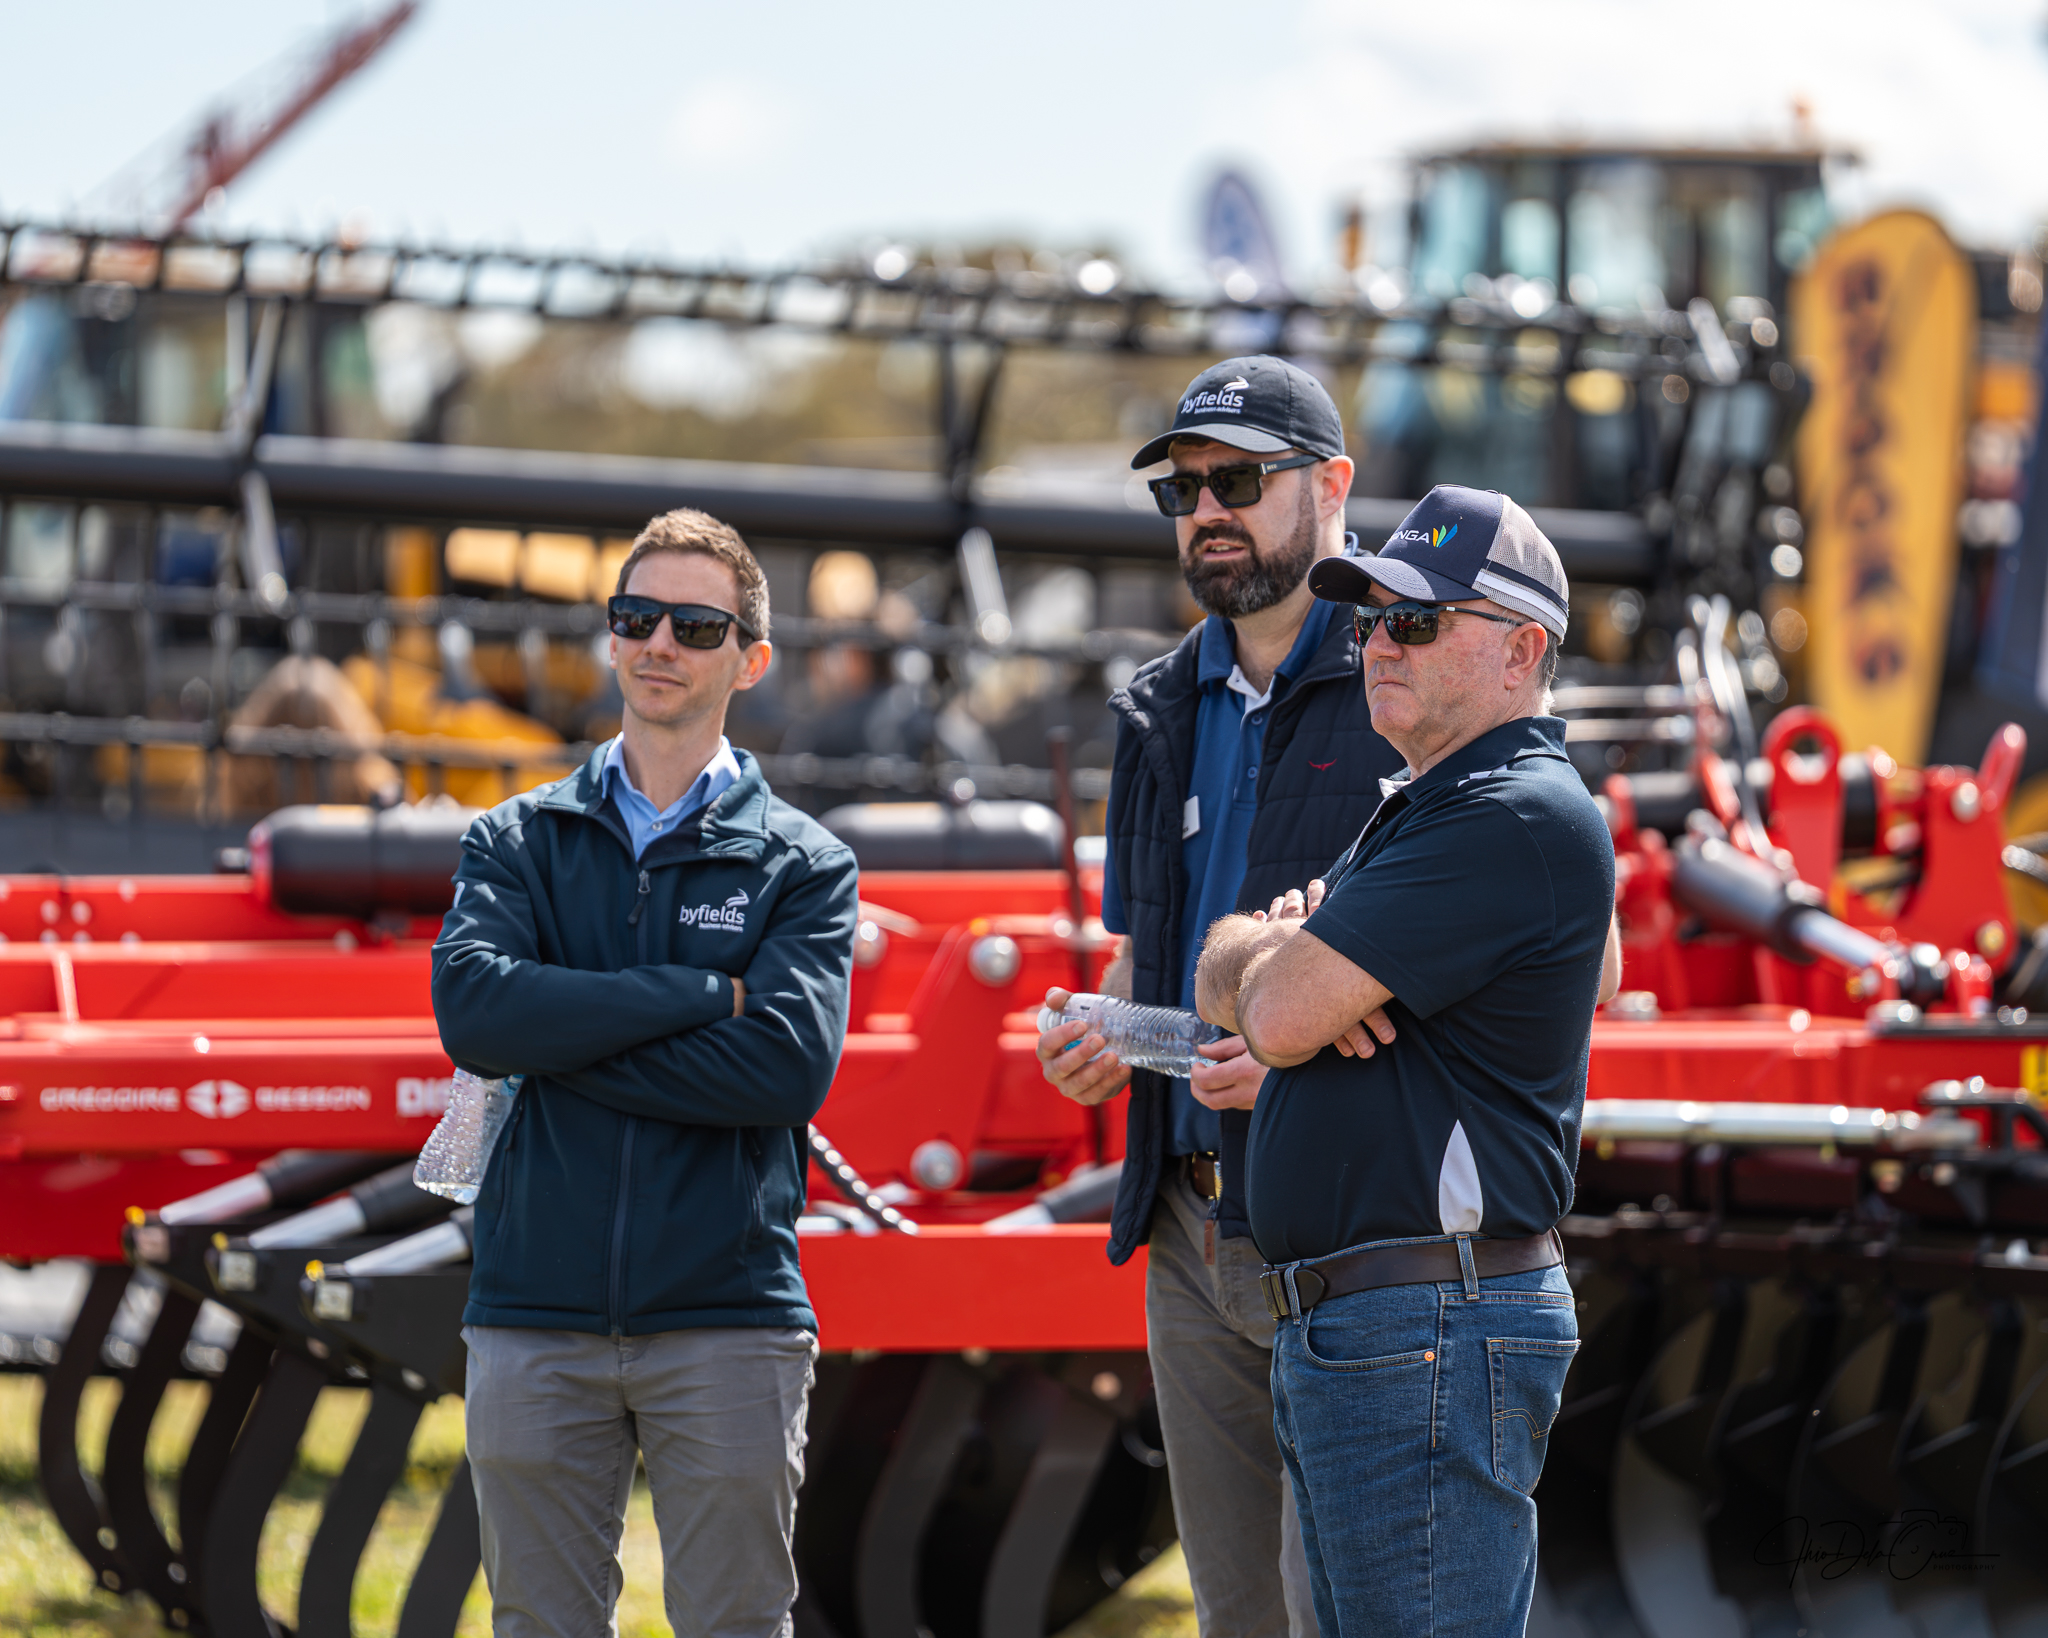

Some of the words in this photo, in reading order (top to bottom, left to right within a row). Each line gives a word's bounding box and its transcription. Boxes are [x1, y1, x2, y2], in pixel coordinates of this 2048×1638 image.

[1181, 390, 1244, 414] byfields
[1392, 529, 1430, 544] NGA
[679, 904, 745, 926] byfields
[255, 1086, 372, 1112] BESSON
